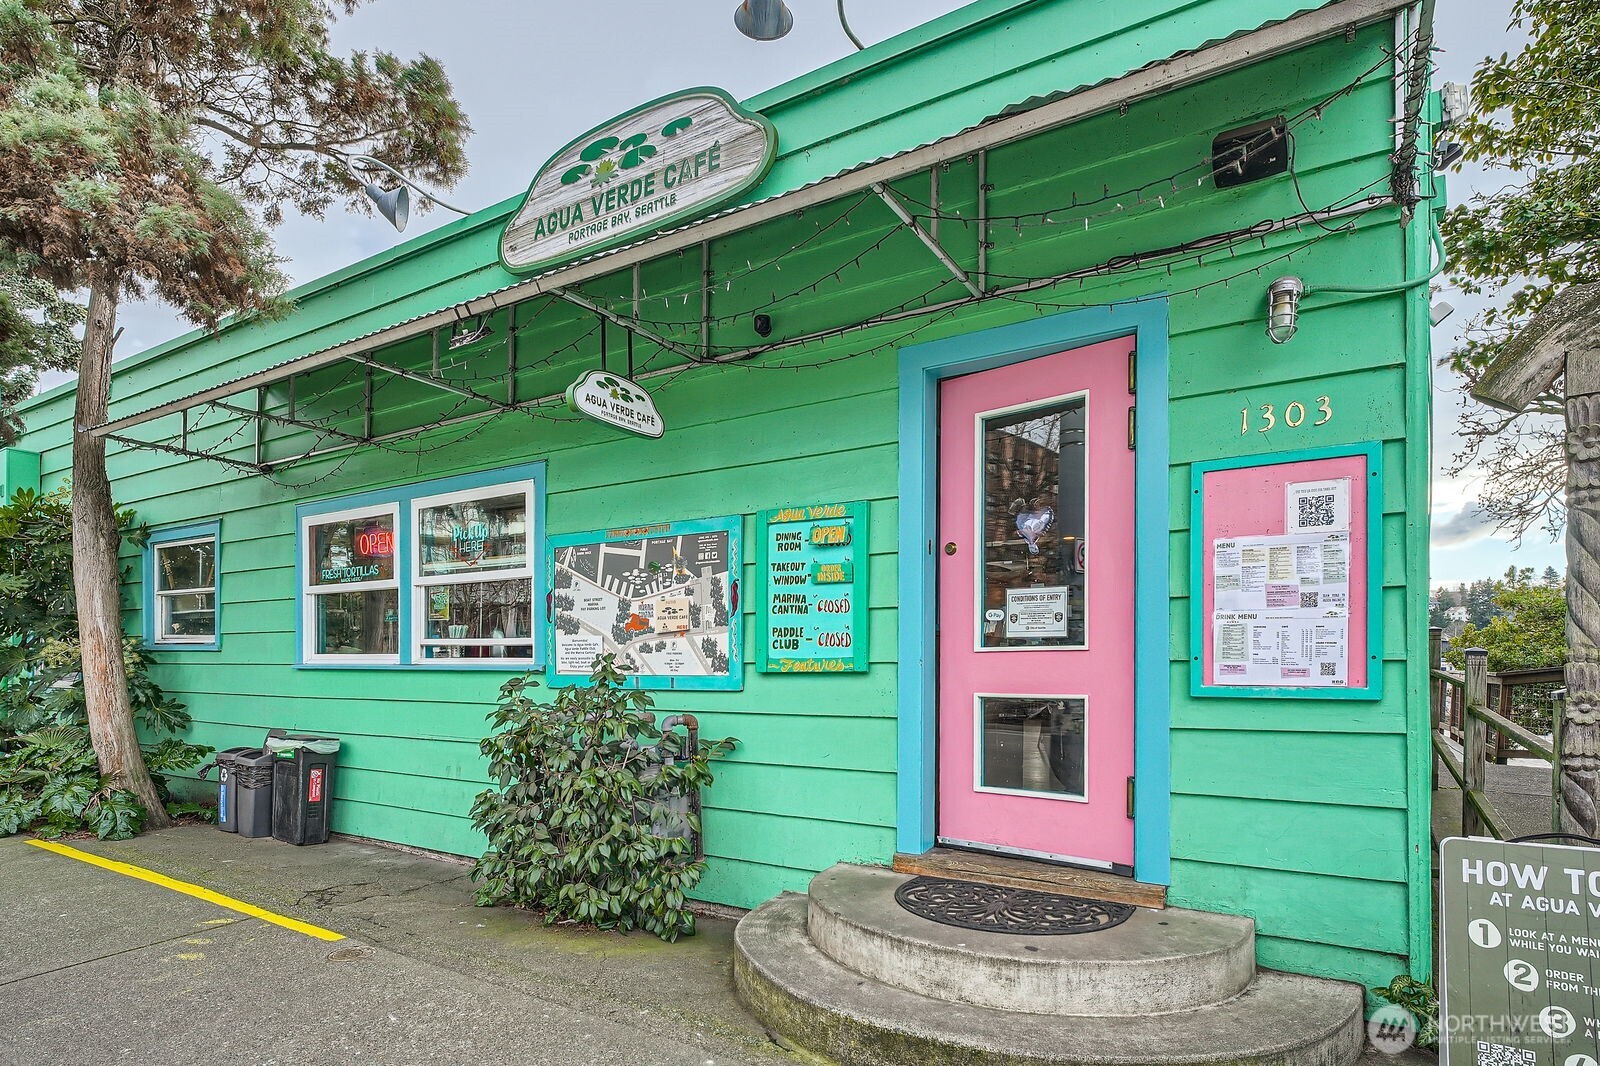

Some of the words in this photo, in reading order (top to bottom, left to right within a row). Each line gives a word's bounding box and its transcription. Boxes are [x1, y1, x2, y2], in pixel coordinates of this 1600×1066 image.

[534, 202, 583, 240] AGUA
[591, 172, 655, 216] VERDE
[664, 140, 720, 189] CAFÉ
[569, 218, 609, 244] PORTAGE
[634, 194, 677, 217] SEATTLE
[585, 393, 607, 409] AGUA
[611, 402, 634, 418] VERDE
[637, 412, 655, 426] CAFÉ
[1241, 396, 1332, 435] 1303
[770, 508, 806, 522] Agua
[807, 504, 846, 518] Verde
[776, 532, 802, 542] DINING
[812, 526, 845, 543] OPEN
[778, 542, 802, 551] ROOM
[322, 568, 341, 580] FRESH
[342, 565, 379, 577] TORTILLAS
[773, 575, 807, 585] WINDOW
[817, 572, 845, 582] INSIDE
[773, 594, 806, 604] MARINA
[817, 599, 850, 614] CLOSED
[772, 605, 808, 614] CANTINA
[772, 627, 804, 637] PADDLE
[772, 639, 799, 650] CLUB
[818, 632, 852, 648] CLOSED
[779, 659, 845, 672] Features
[1462, 858, 1549, 891] HOW
[1489, 891, 1513, 907] AT
[1521, 895, 1580, 916] AGUA
[1478, 923, 1490, 946] 1
[1509, 928, 1537, 939] LOOK
[1541, 932, 1555, 941] AT
[1559, 934, 1567, 943] A
[1509, 938, 1545, 951] WHILE
[1549, 943, 1572, 955] YOU
[1513, 963, 1532, 986] 2
[1546, 969, 1584, 982] ORDER
[1546, 980, 1578, 992] FROM
[1583, 986, 1600, 996] TH
